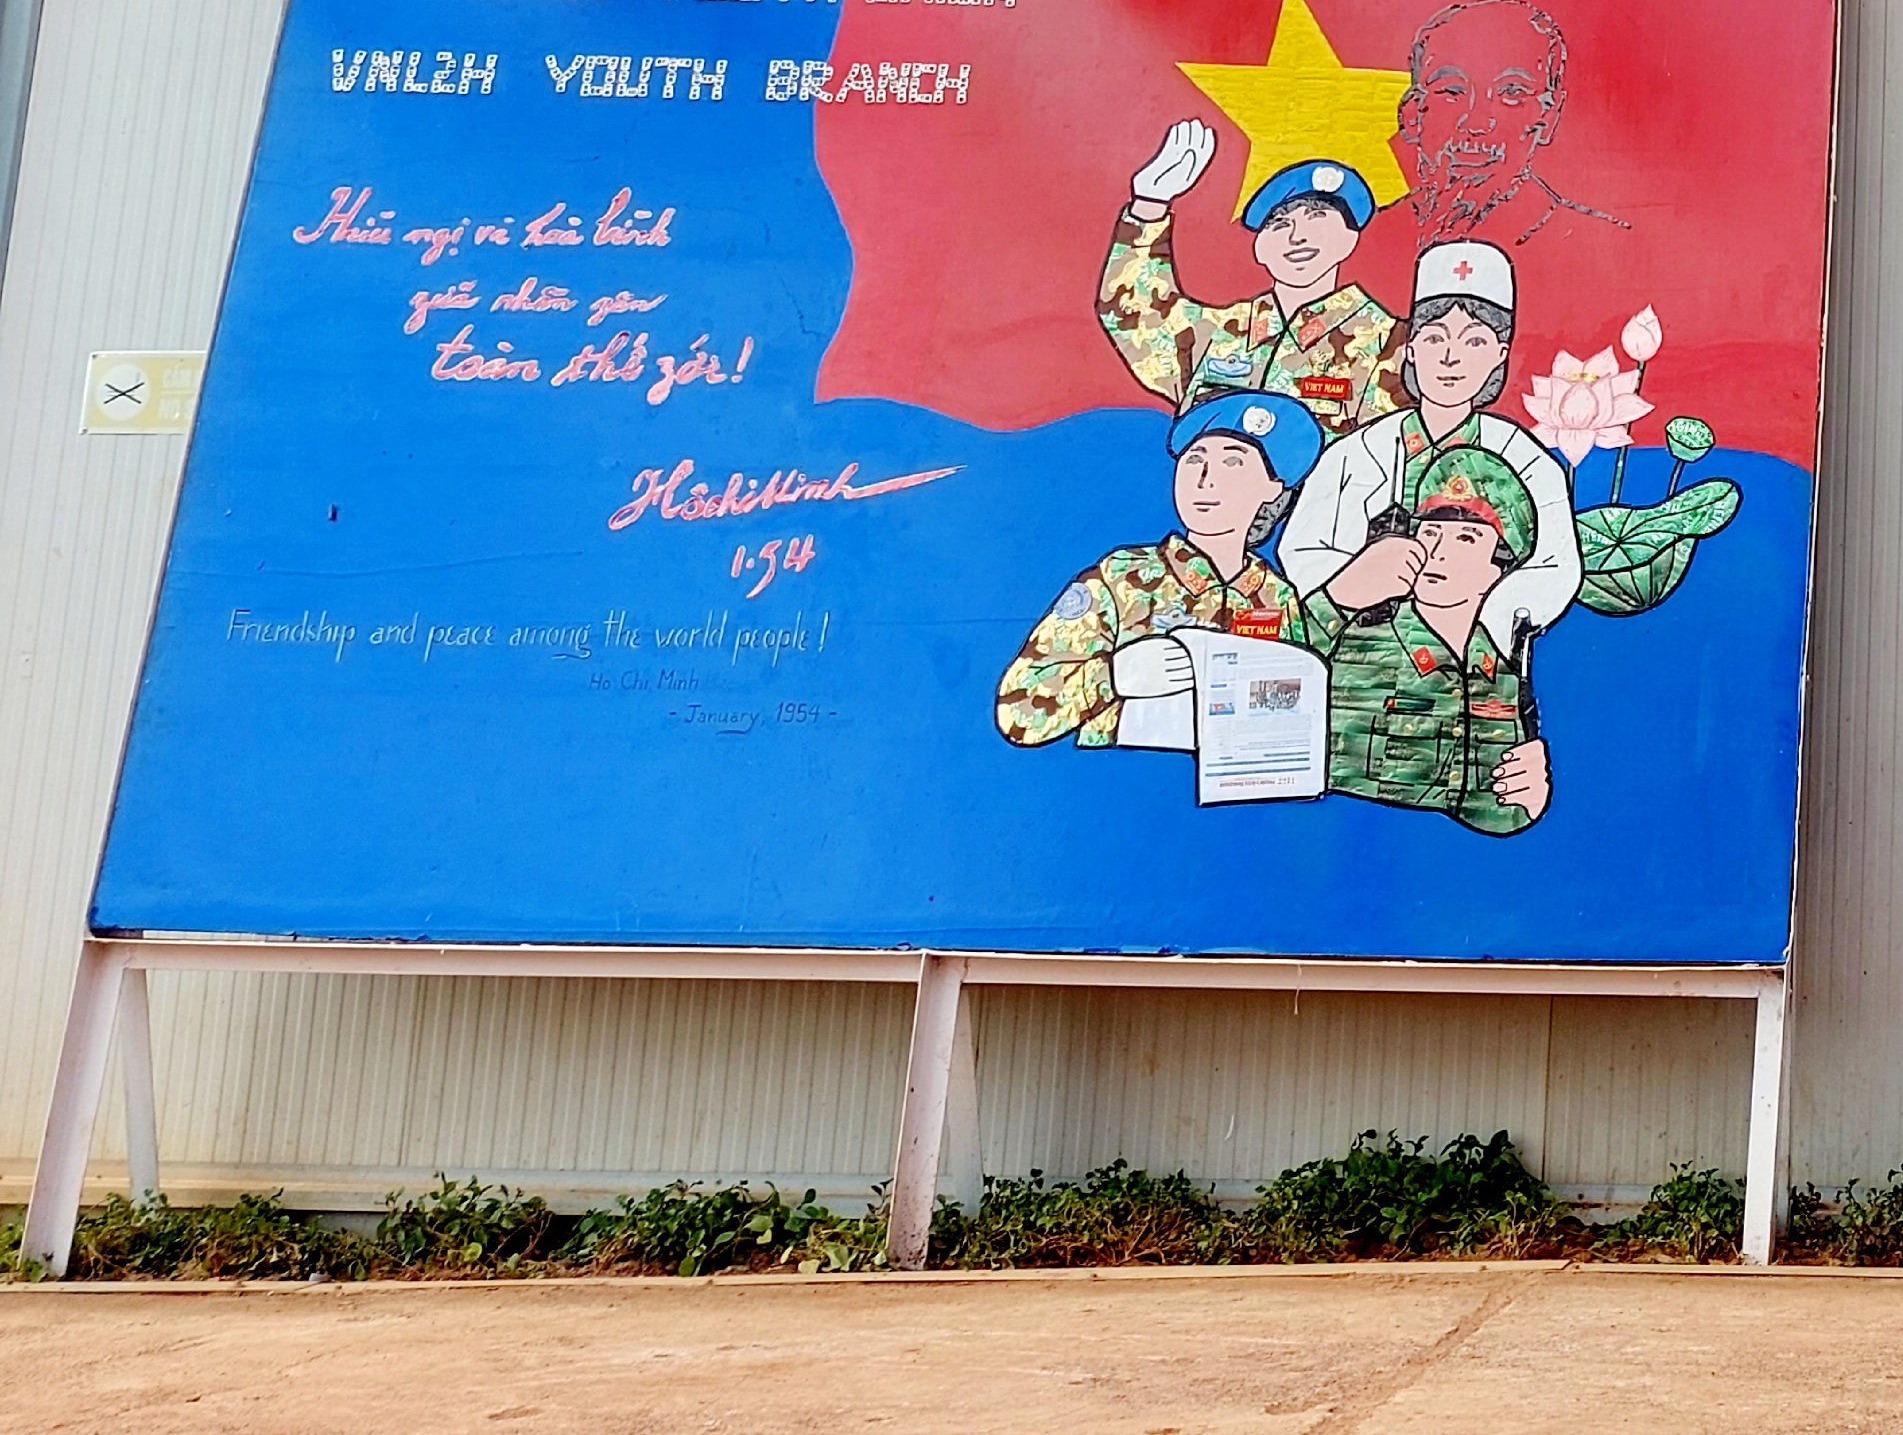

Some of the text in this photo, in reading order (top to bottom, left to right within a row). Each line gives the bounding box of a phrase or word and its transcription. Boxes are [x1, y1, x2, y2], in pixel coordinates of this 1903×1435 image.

[545, 54, 728, 100] YOUTH
[766, 60, 971, 103] BRANCH
[1305, 382, 1344, 394] VIET NAM
[226, 609, 356, 663] Friendship
[369, 611, 419, 645] and
[424, 624, 496, 663] peace
[508, 623, 592, 659] among
[603, 610, 641, 649] the
[655, 610, 728, 649] world
[1236, 625, 1277, 636] VIET NAM
[620, 670, 649, 691] Chi
[657, 669, 699, 691] Minh
[774, 702, 820, 724] 1954
